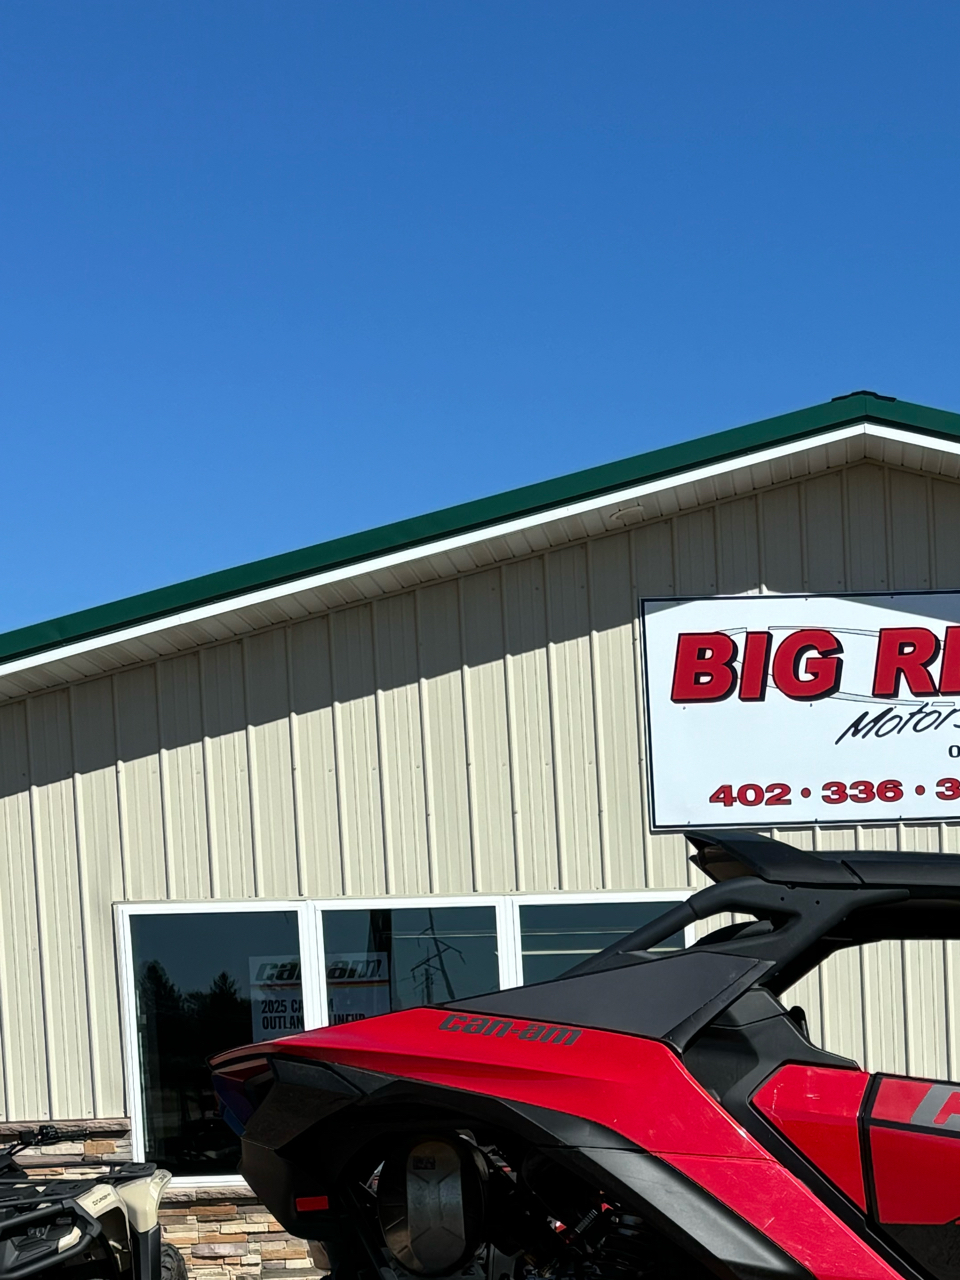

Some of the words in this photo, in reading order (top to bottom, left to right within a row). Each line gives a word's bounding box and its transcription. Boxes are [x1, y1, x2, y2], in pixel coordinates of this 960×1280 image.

[670, 629, 844, 703] BIG
[709, 783, 792, 807] 402
[821, 779, 904, 804] 336
[261, 999, 288, 1014] 2025
[438, 1013, 583, 1046] can-am
